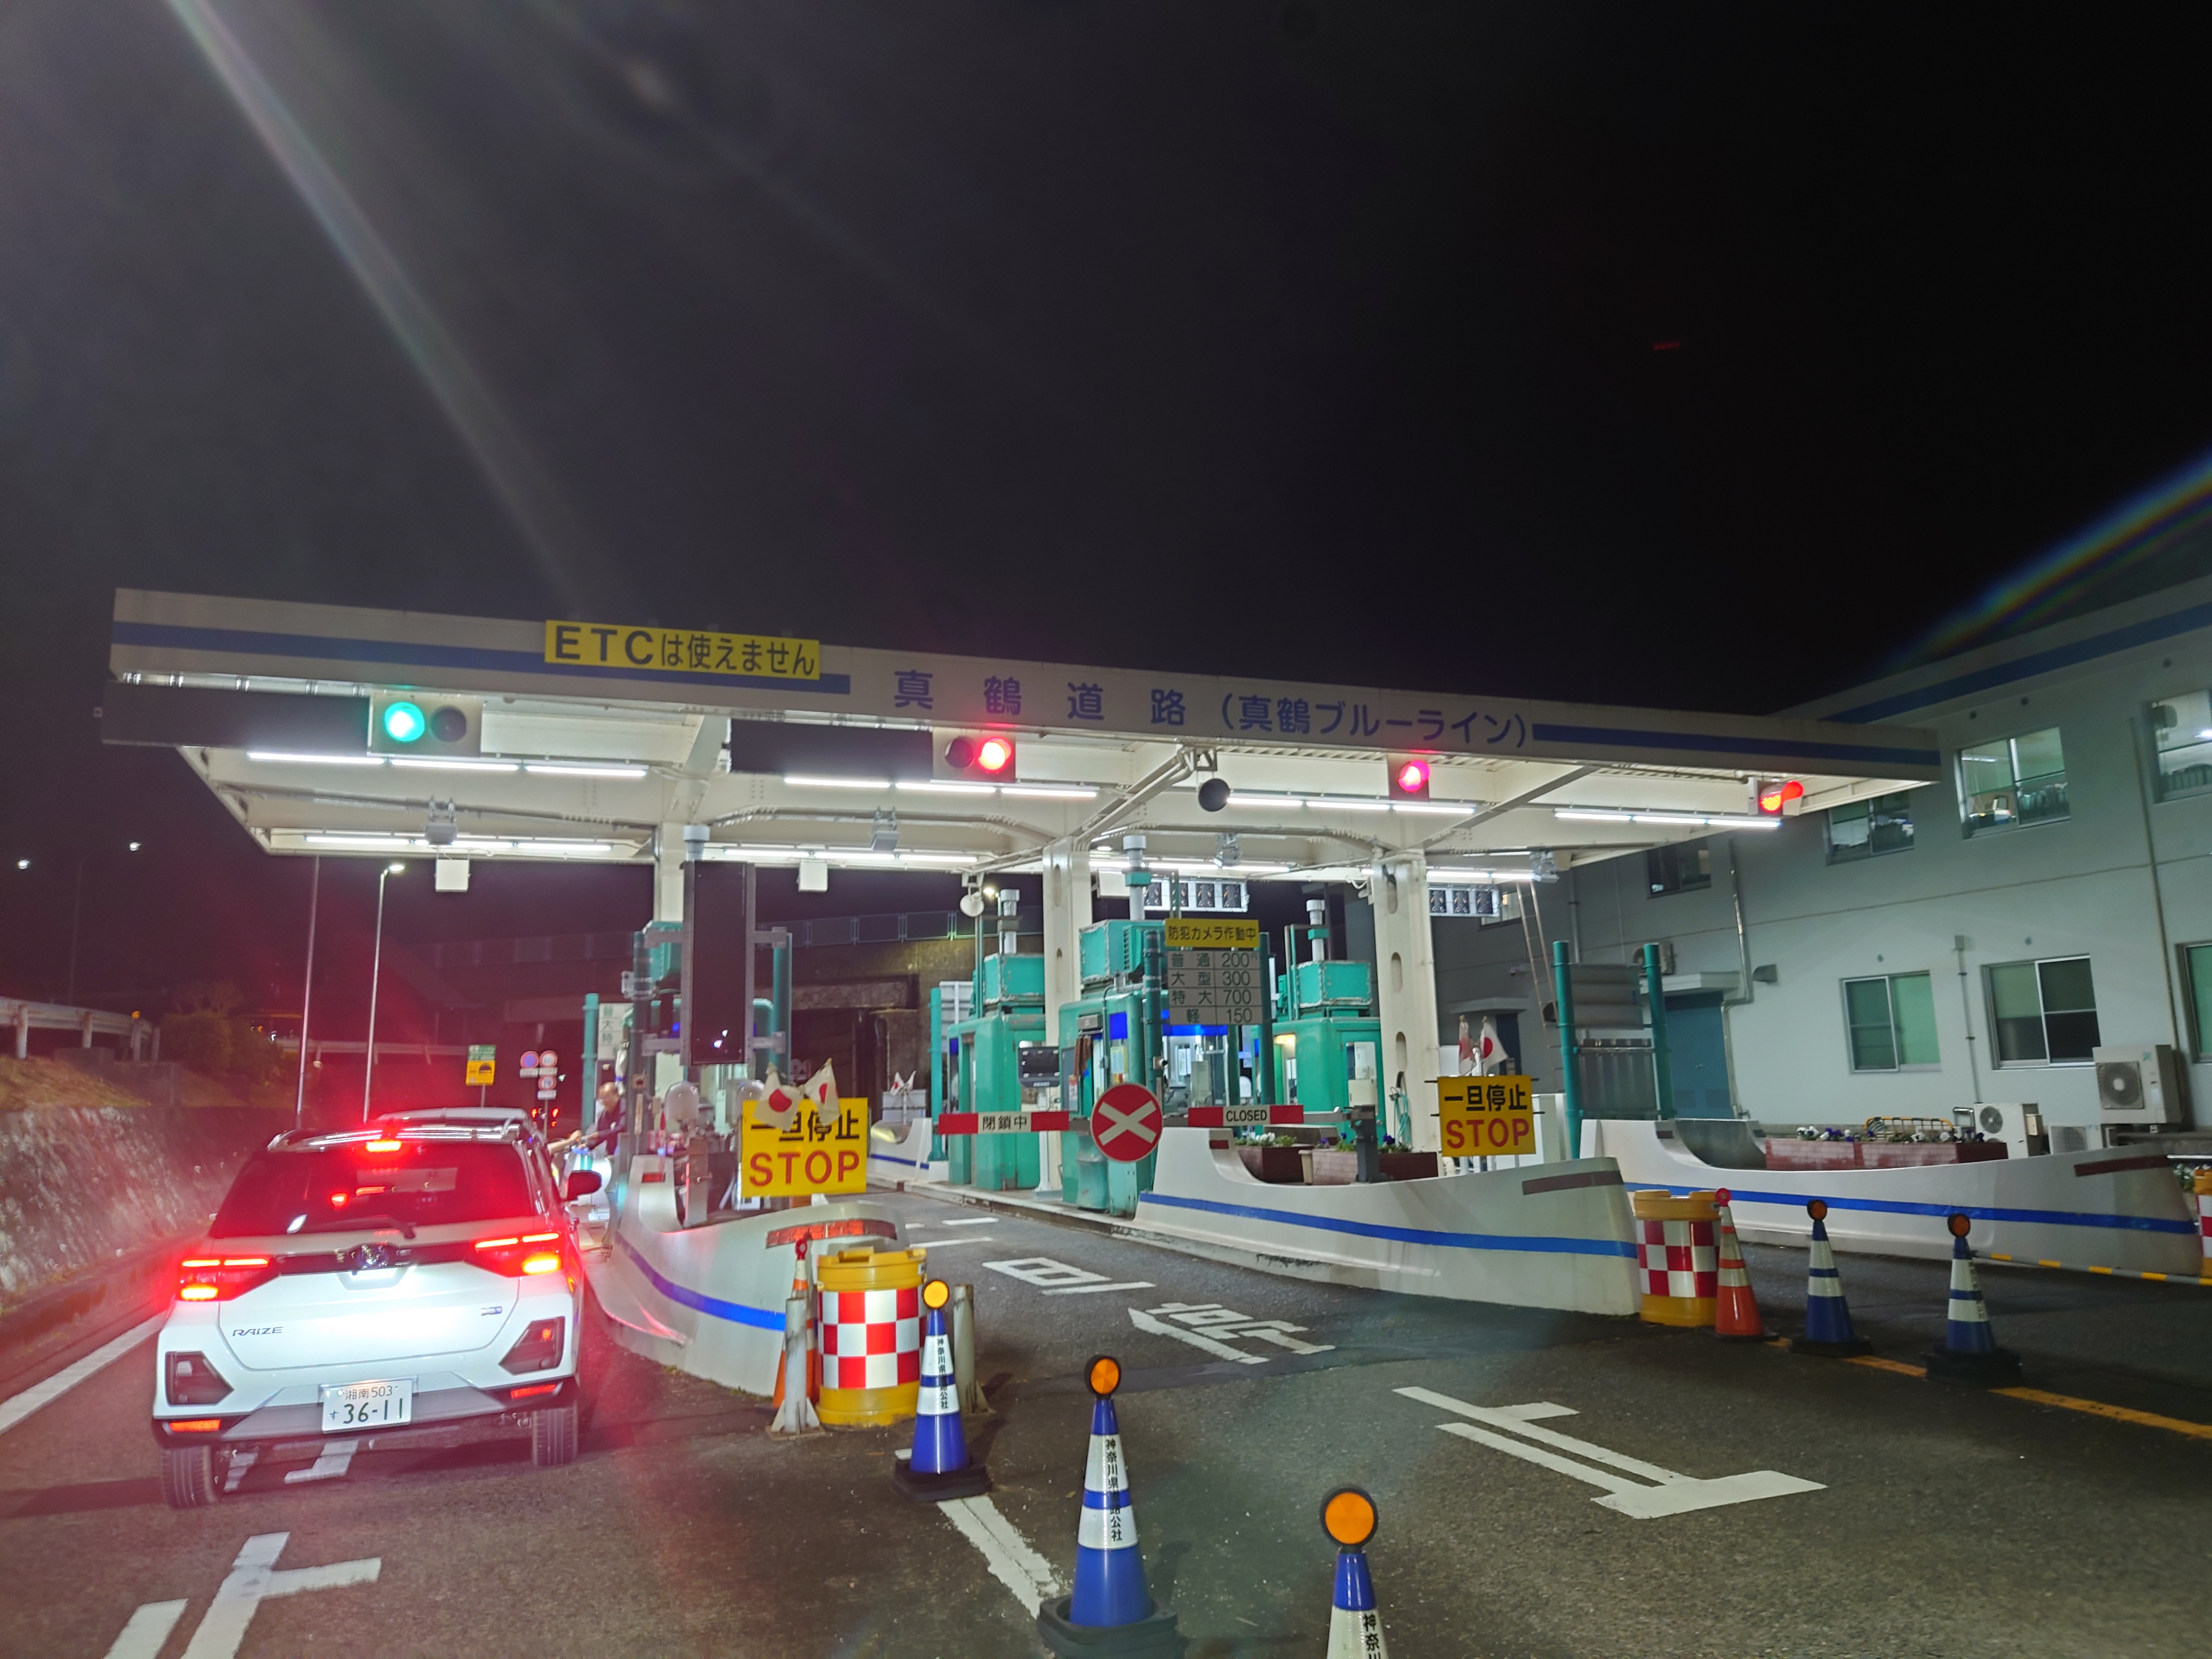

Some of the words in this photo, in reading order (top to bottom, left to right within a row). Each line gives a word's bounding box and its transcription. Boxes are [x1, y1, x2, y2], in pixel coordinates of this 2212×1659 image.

[555, 625, 814, 675] ETCは使えません
[894, 670, 1186, 726] 真鶴道路
[1168, 925, 1256, 941] 防犯カメラ作動中
[1171, 952, 1210, 968] 普通
[1171, 971, 1211, 986] 大型
[1222, 970, 1250, 986] 300
[1172, 989, 1212, 1005] 特大
[1223, 989, 1251, 1005] 700
[1186, 1008, 1199, 1023] 軽
[1226, 1008, 1252, 1023] 150
[1444, 1084, 1527, 1111] 一旦停止
[983, 1114, 1027, 1130] 閉鎖中
[1226, 1109, 1267, 1122] CLOSED
[1446, 1118, 1529, 1149] STOP
[749, 1150, 859, 1187] STOP
[232, 1327, 284, 1336] RAIZE
[937, 1338, 949, 1409] 神奈川県路公社
[371, 1385, 393, 1398] 503
[343, 1397, 403, 1424] 36-11
[1105, 1437, 1122, 1542] 神奈川県路公社
